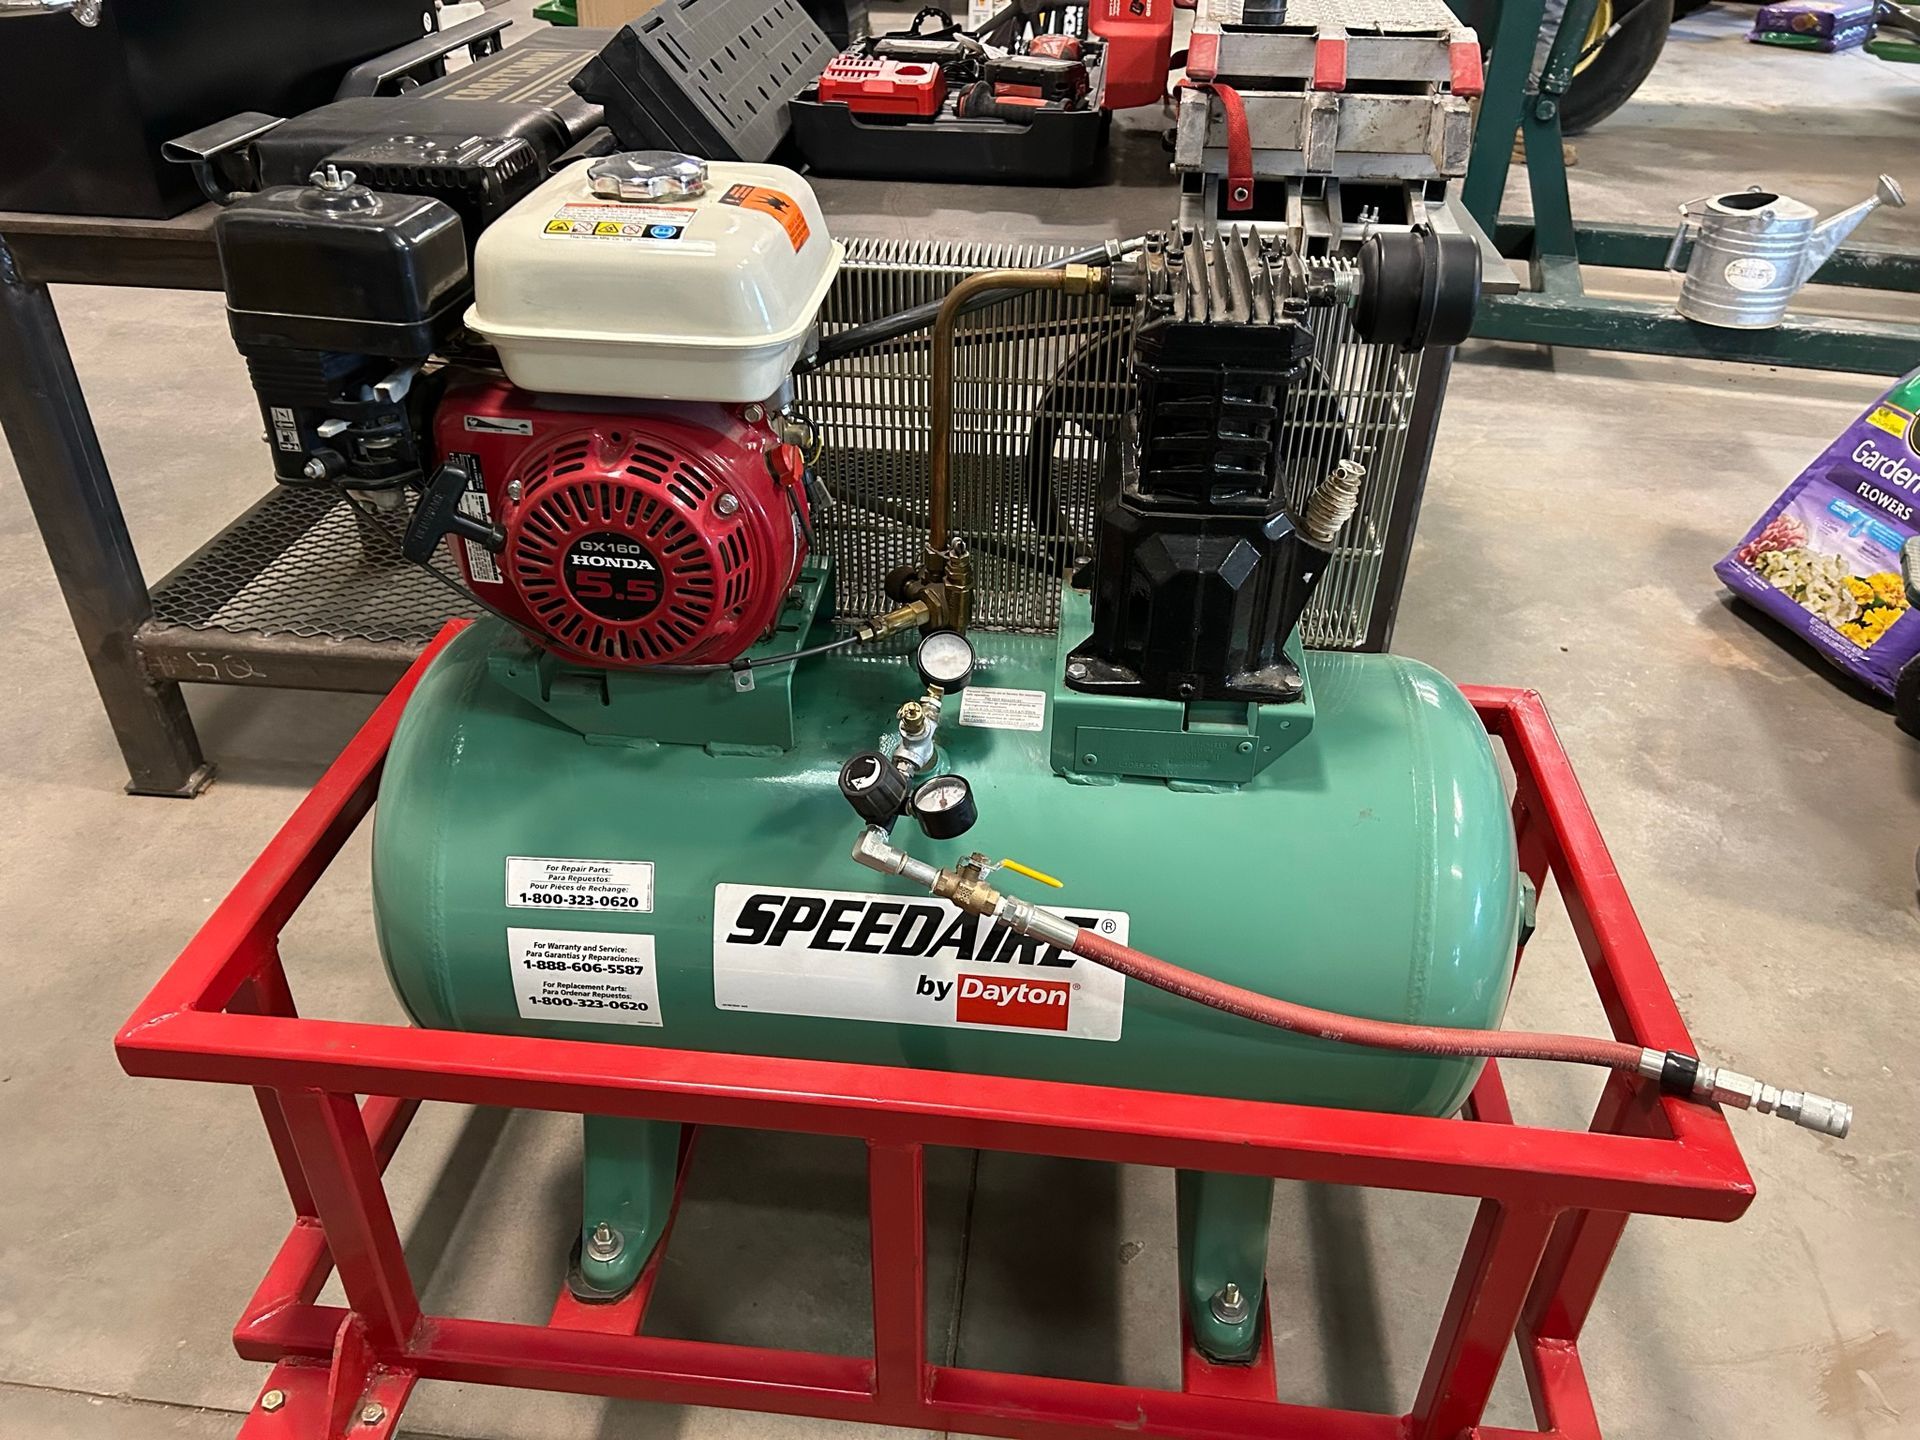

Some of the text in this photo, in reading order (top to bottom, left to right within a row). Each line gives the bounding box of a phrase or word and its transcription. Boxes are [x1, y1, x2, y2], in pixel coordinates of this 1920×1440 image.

[443, 51, 573, 101] CRAFTSMAN
[1856, 482, 1913, 521] FLOWERS
[580, 541, 641, 554] GX160
[571, 554, 656, 571] HONDA
[575, 570, 657, 602] 5.5
[560, 865, 587, 873] Repair
[568, 875, 611, 884] Repuestos:
[530, 882, 548, 890] Pour
[588, 885, 629, 894] Rechange:
[519, 892, 639, 908] 1-800-323-0620
[547, 942, 581, 952] Warranty
[583, 944, 597, 952] and
[599, 945, 628, 954] Service:
[581, 953, 587, 961] y
[588, 953, 640, 963] Reparaciones:
[523, 959, 644, 976] 1-888-606-5587
[557, 982, 604, 991] Replacement
[916, 975, 1068, 1008] by Dayton
[542, 988, 633, 1000] Para Ordenar Repuestos:
[528, 996, 649, 1012] 1-800-323-0620
